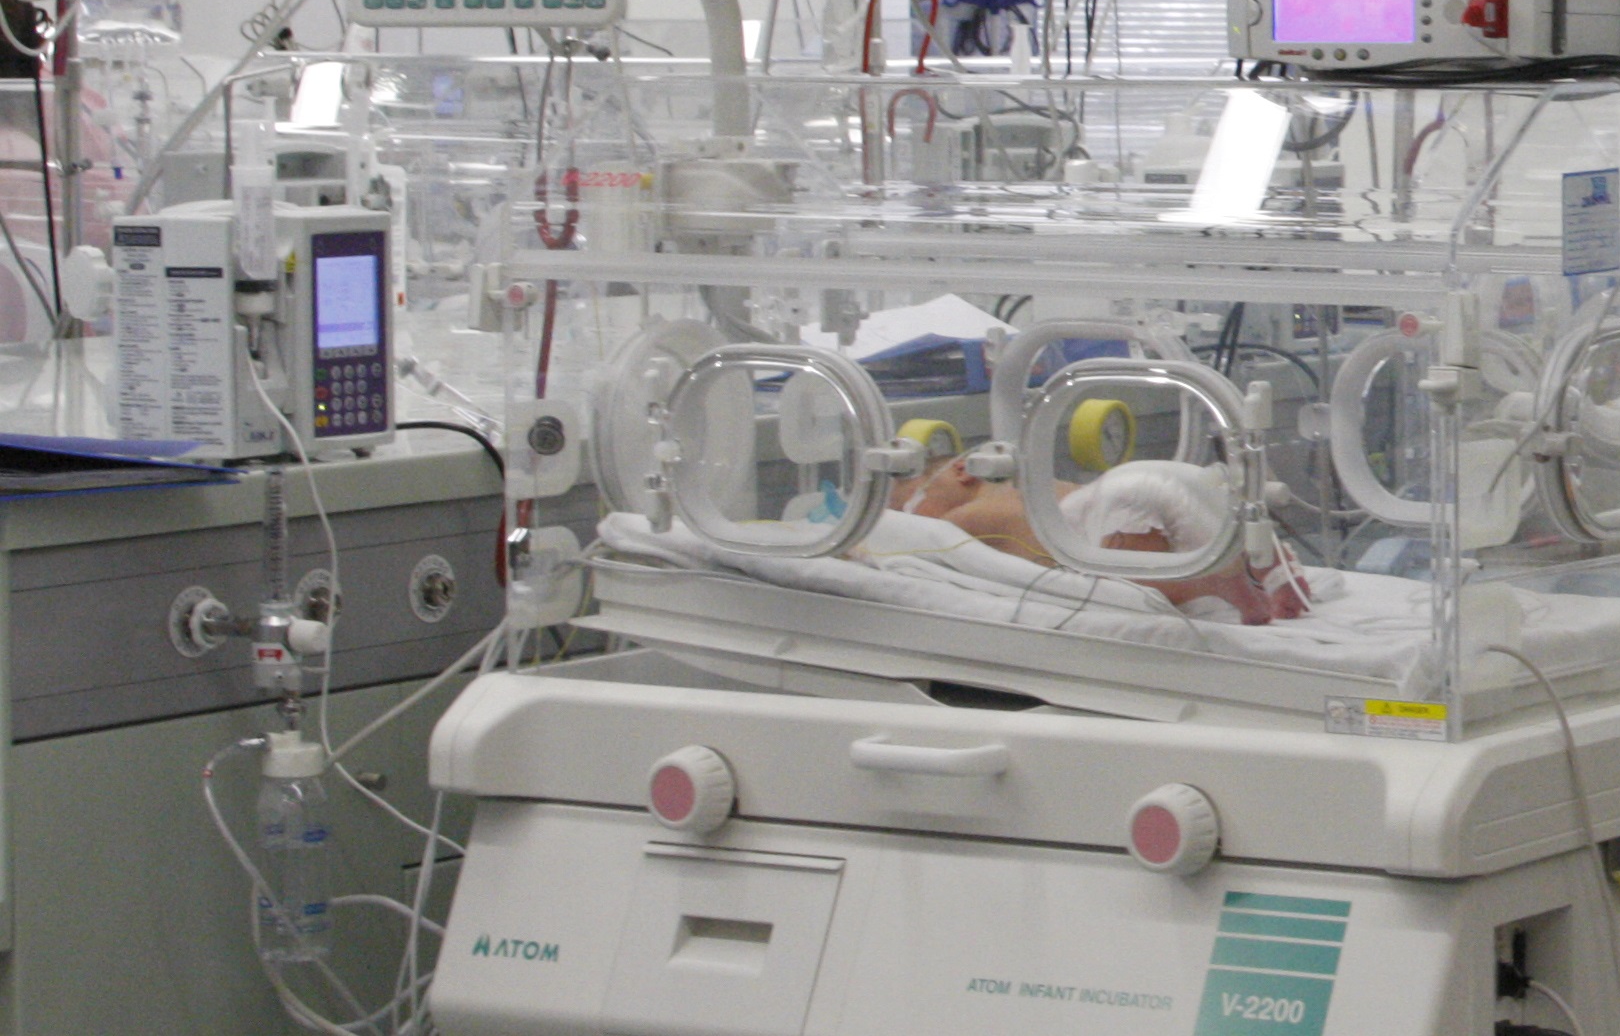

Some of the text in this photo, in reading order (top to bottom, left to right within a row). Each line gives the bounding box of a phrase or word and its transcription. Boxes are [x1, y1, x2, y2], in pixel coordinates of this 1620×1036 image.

[493, 938, 560, 962] ATOM
[966, 978, 1173, 1010] ATOM INFANT INCUBATOR
[1221, 992, 1305, 1023] V-2200
